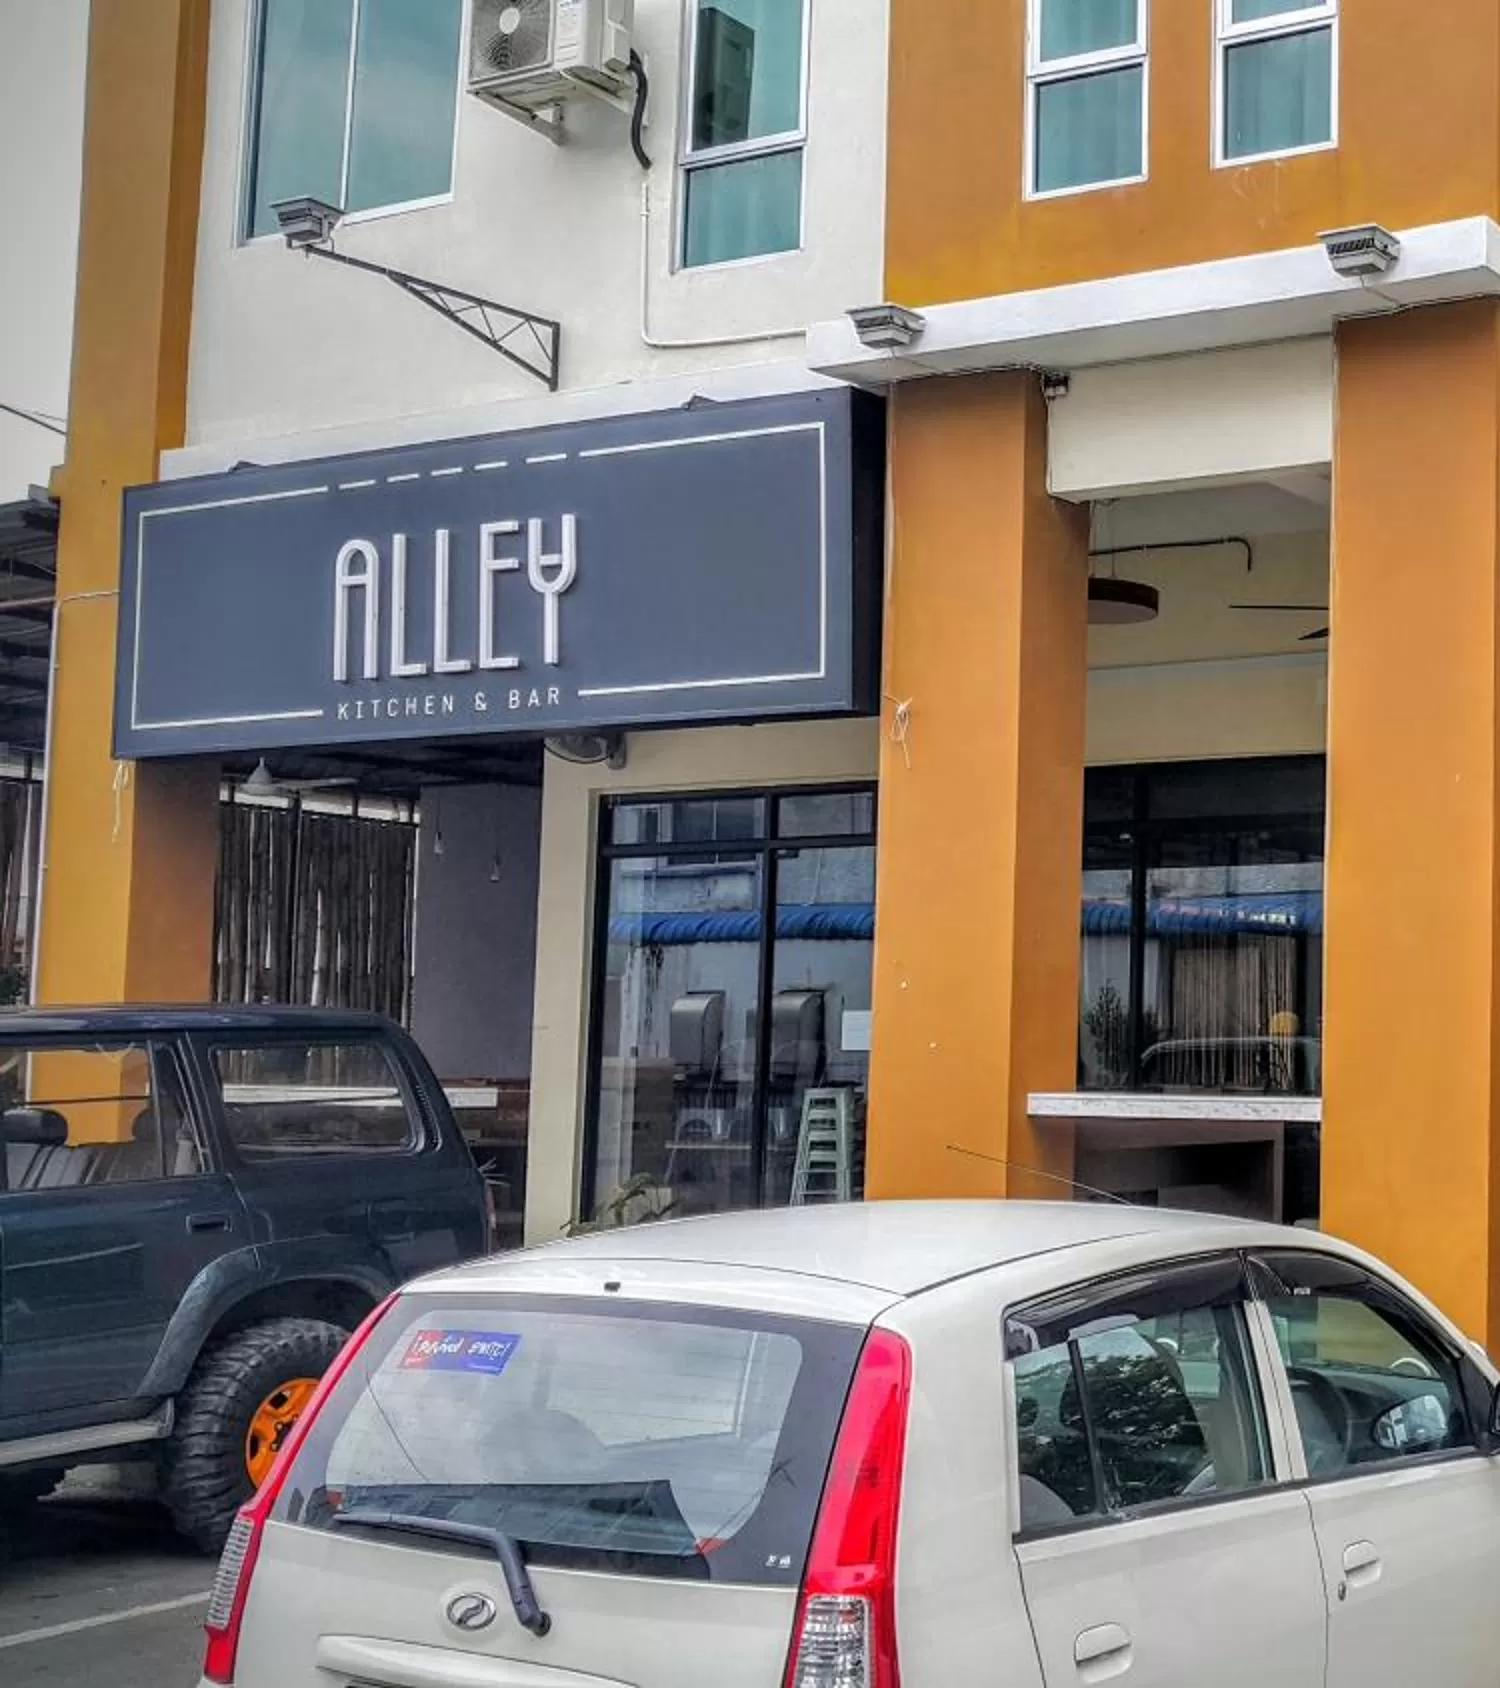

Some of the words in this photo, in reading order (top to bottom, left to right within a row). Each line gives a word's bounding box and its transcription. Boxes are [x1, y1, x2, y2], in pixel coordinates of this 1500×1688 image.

[333, 512, 578, 682] ALLEY
[337, 695, 454, 721] KITCHEN
[475, 692, 488, 711] &
[508, 687, 561, 709] BAR
